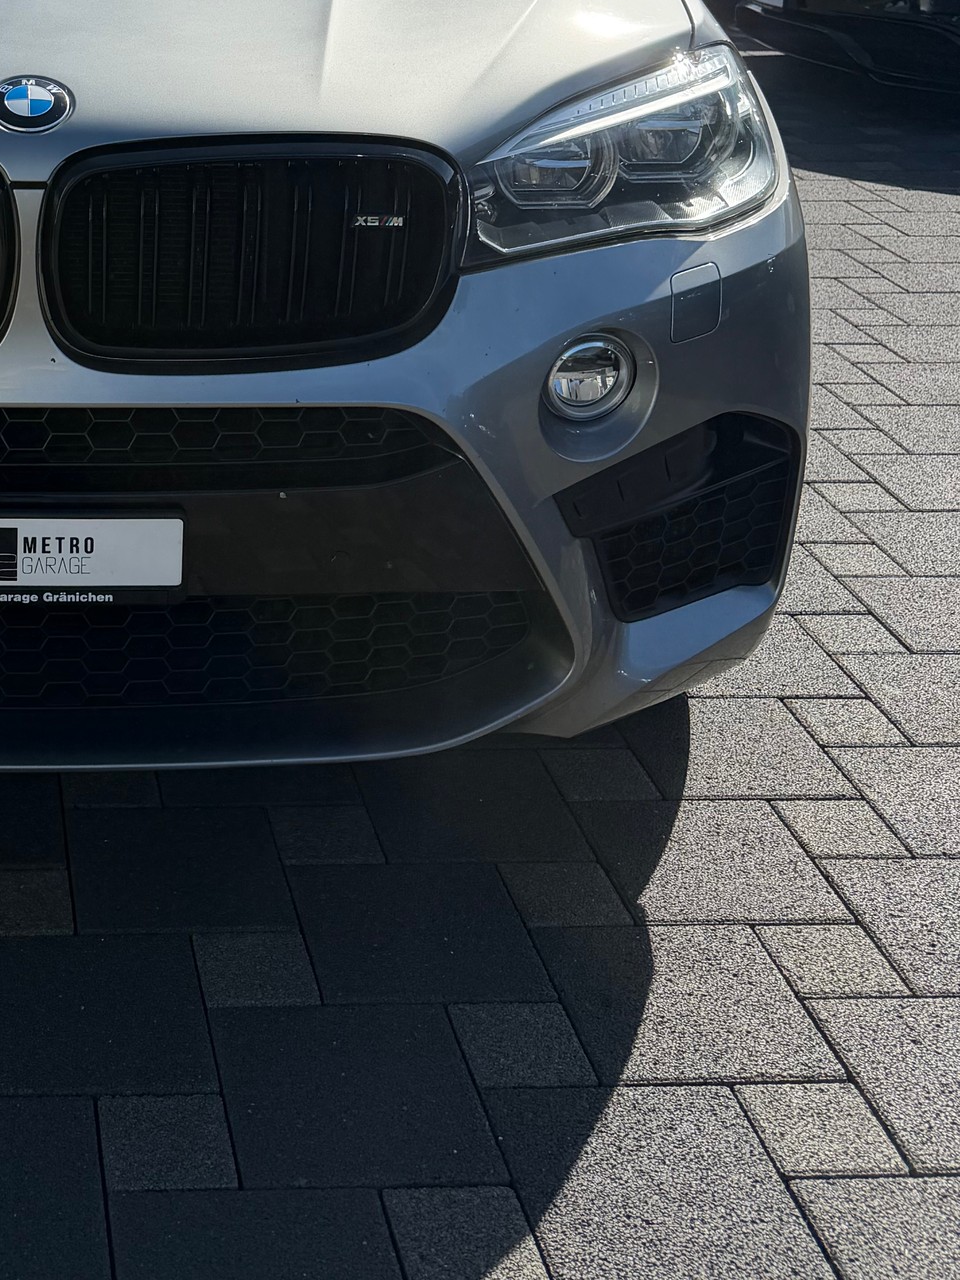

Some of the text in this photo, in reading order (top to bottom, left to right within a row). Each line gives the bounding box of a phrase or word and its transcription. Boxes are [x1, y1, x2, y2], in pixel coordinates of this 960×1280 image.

[22, 536, 95, 554] METRO
[21, 556, 91, 575] GARAGE
[42, 592, 114, 603] Gränichen
